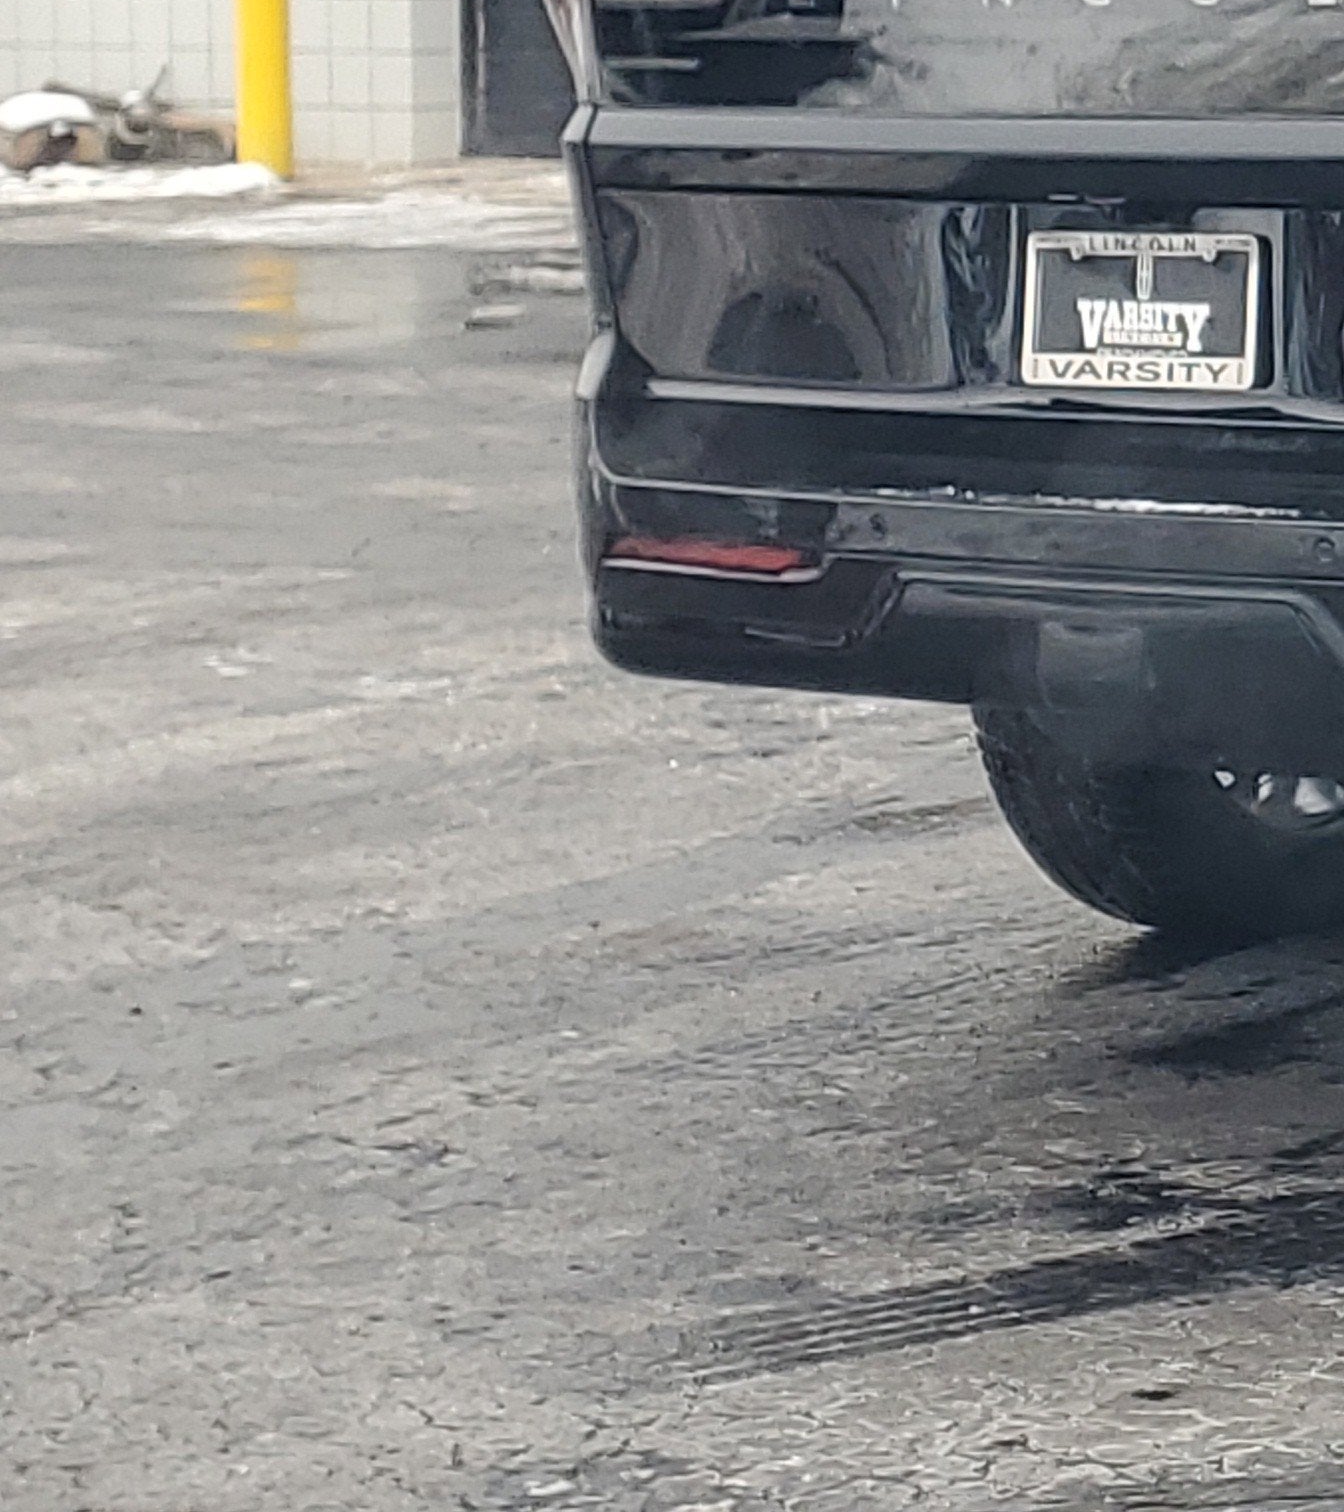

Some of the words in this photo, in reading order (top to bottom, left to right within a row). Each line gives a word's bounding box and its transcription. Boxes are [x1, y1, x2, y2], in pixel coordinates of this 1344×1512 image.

[1087, 236, 1197, 253] LINCOLN
[1076, 297, 1210, 352] VARSITY
[1048, 358, 1230, 384] VARSITY
